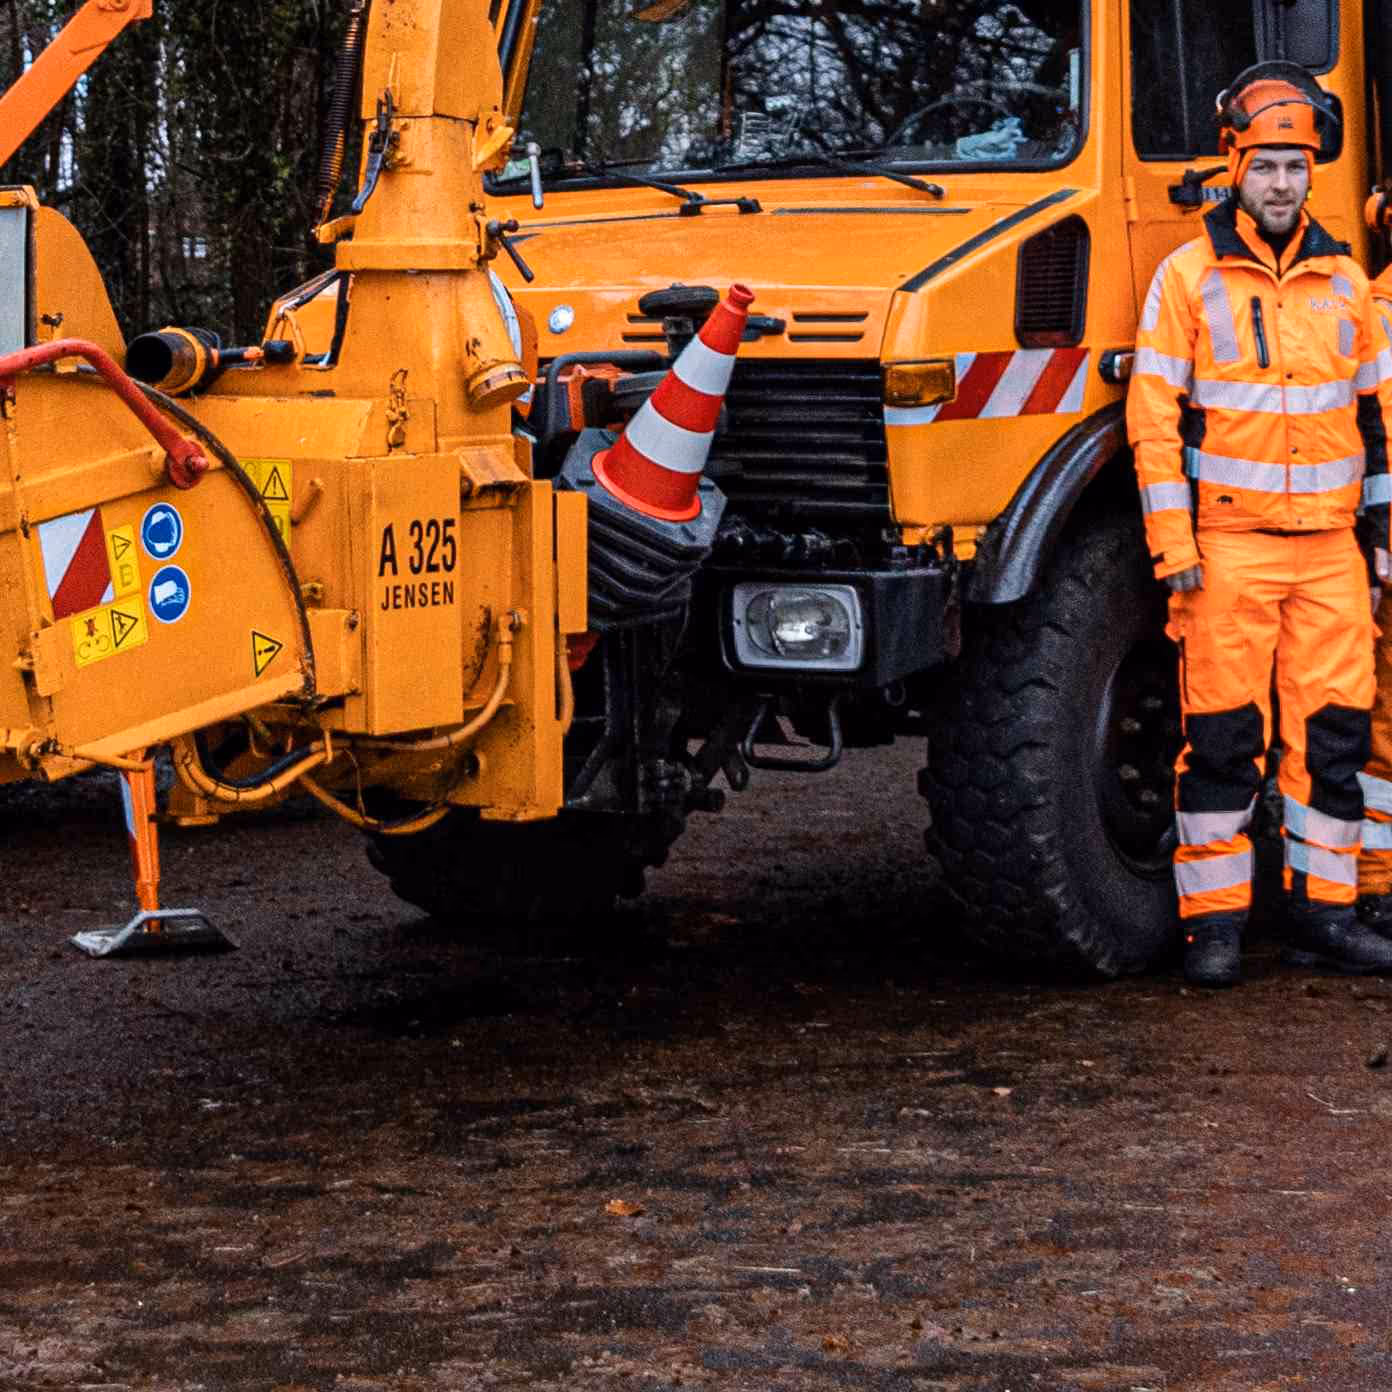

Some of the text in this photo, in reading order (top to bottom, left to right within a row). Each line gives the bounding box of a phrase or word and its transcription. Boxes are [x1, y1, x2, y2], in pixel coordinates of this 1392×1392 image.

[379, 518, 457, 576] A 325
[381, 581, 454, 611] JENSEN
